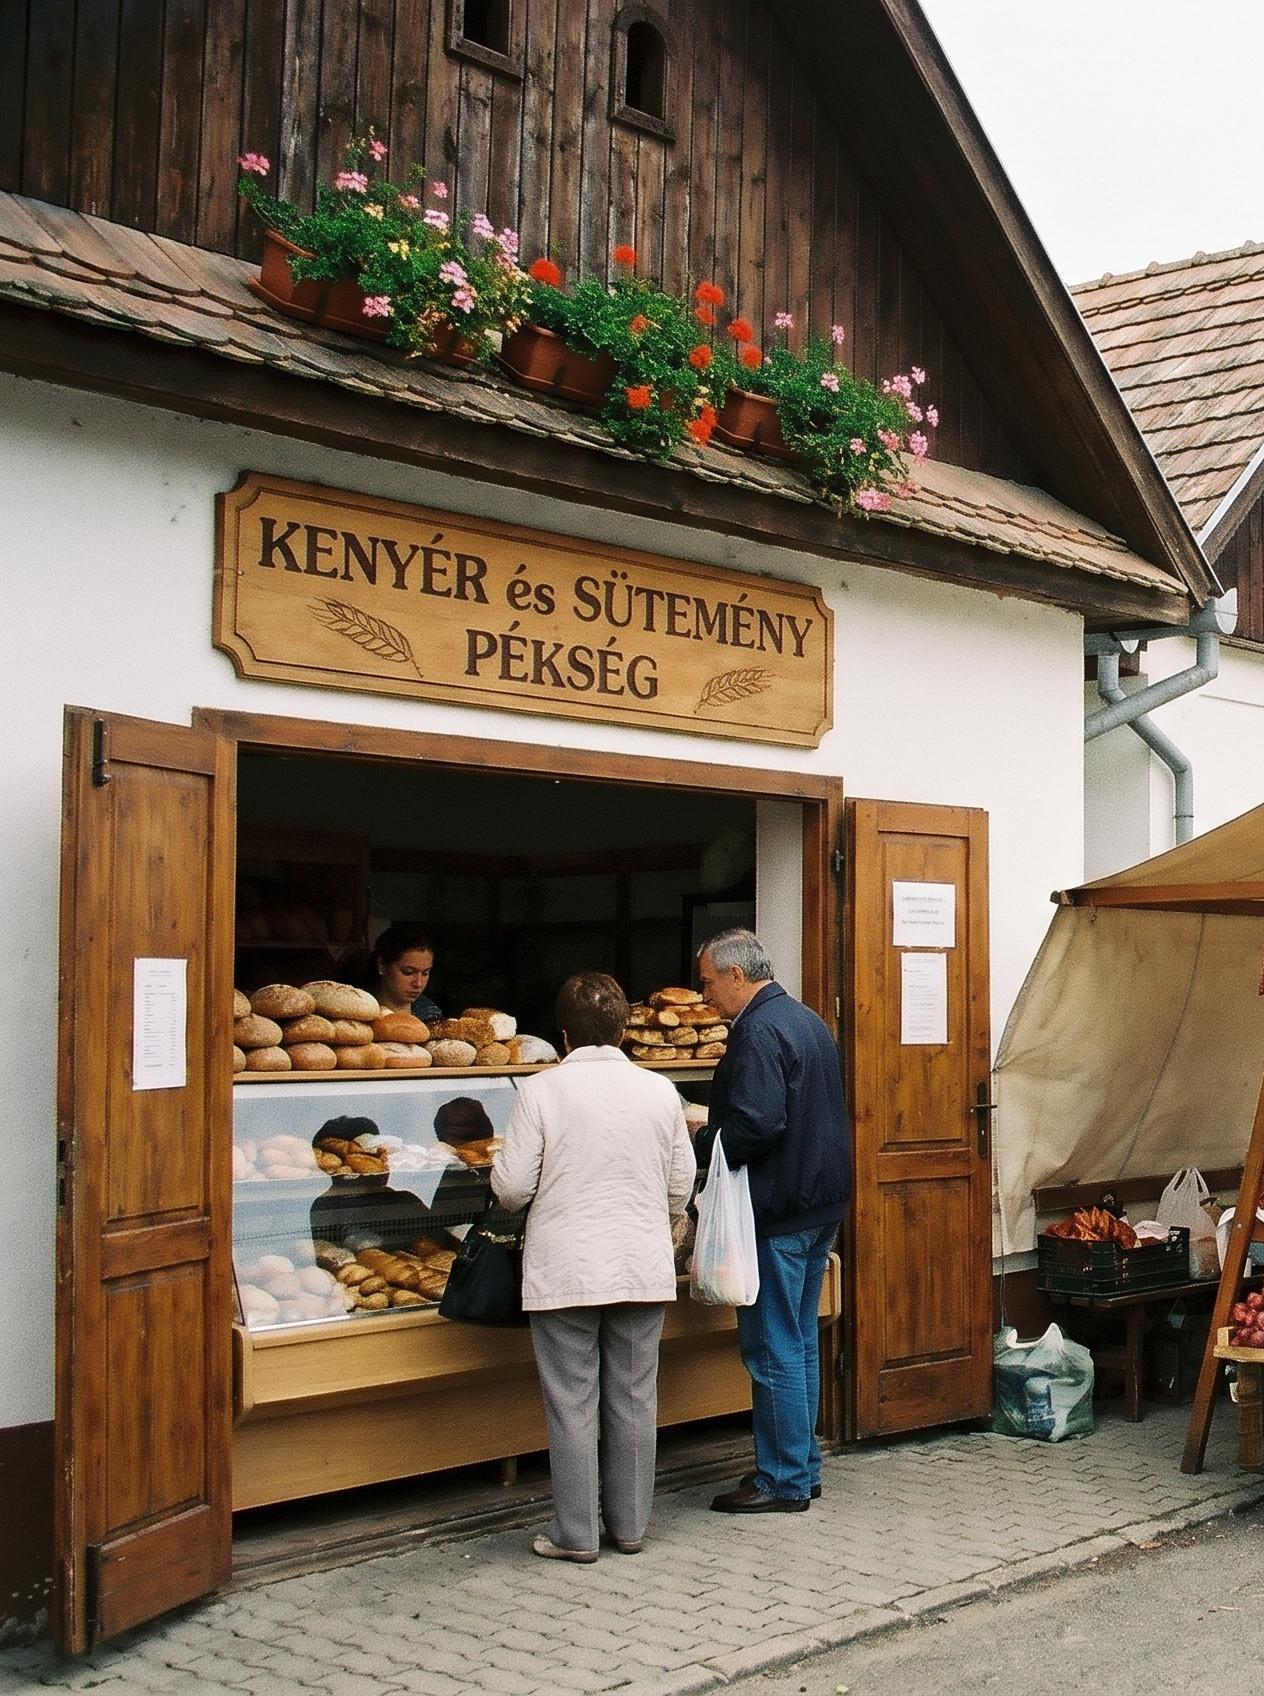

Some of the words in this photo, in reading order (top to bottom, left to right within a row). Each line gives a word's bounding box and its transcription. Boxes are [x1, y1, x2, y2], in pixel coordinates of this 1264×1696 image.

[258, 517, 489, 604] KENYÉR
[505, 564, 555, 616] és
[572, 569, 814, 659] SÜTEMÉNY
[464, 620, 659, 700] PÉKSÉG
